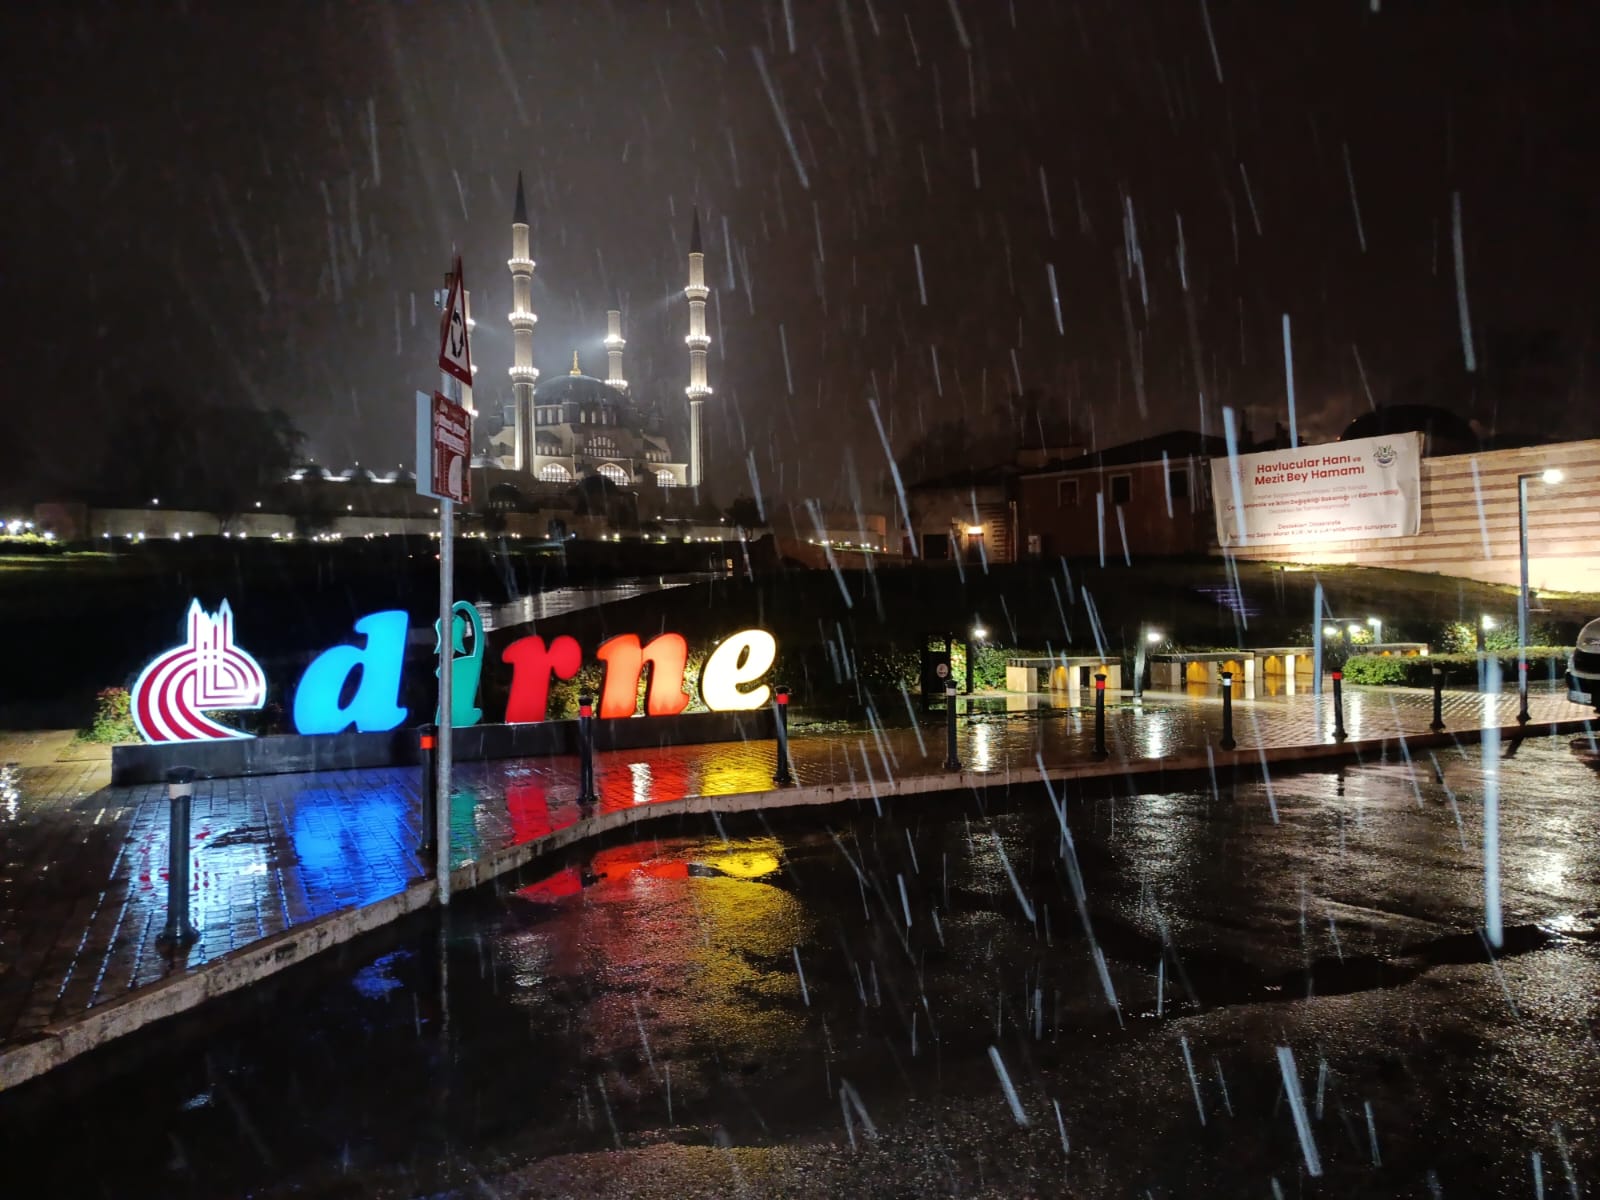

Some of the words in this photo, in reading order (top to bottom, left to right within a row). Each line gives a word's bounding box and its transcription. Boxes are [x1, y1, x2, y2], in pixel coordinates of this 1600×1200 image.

[1257, 459, 1320, 474] Havlucular
[1322, 455, 1351, 466] Hanı
[1255, 474, 1285, 485] Mezit
[1287, 472, 1308, 483] Bey
[1311, 466, 1365, 479] Hamamı
